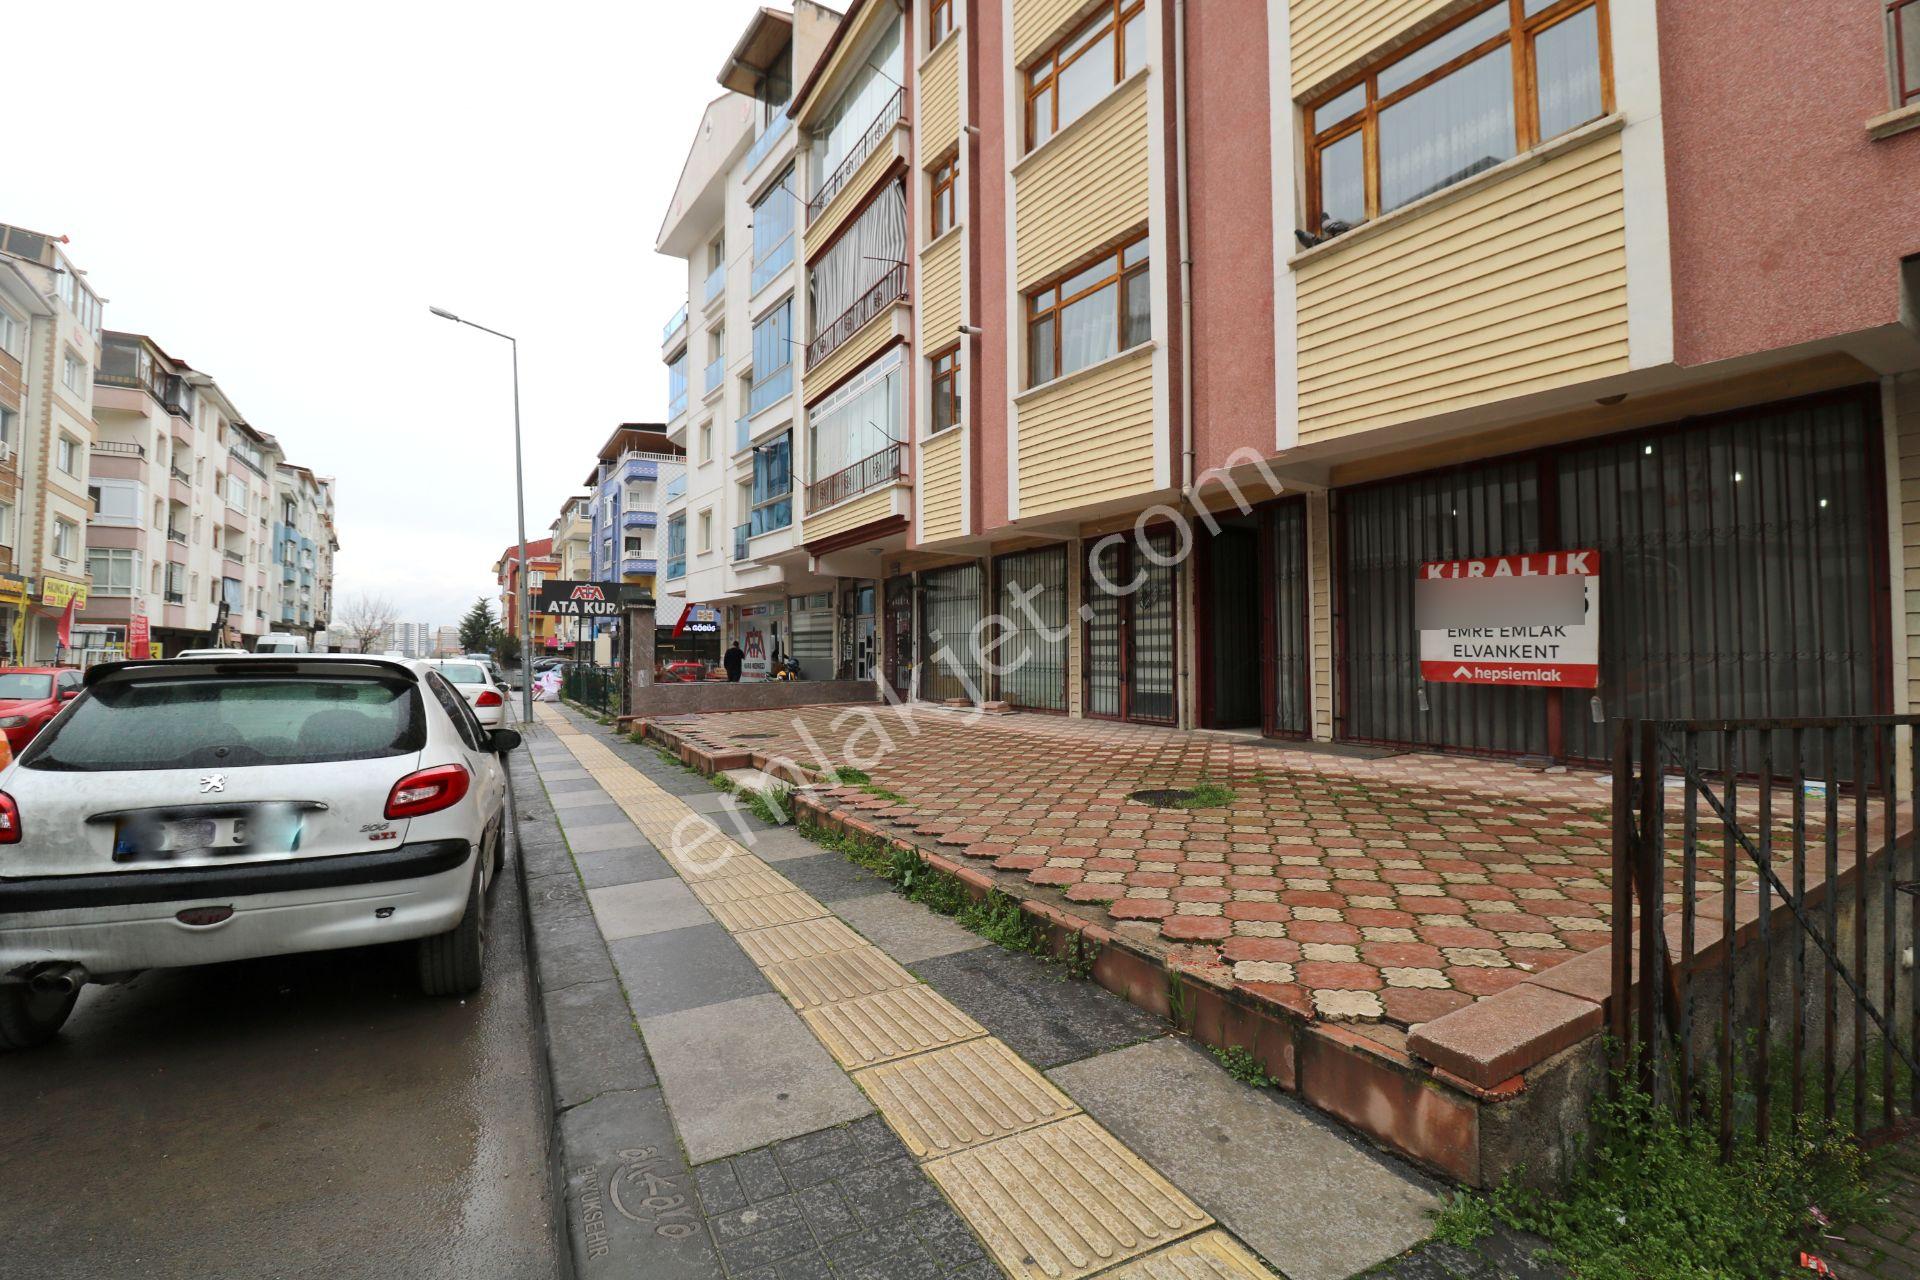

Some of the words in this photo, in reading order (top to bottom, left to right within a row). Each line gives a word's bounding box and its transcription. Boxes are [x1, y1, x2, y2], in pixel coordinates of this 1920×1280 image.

[548, 600, 579, 614] ATA
[584, 601, 619, 615] KUR
[1447, 627, 1494, 638] EMRE
[1500, 625, 1566, 638] EMLAK
[1453, 644, 1560, 659] ELVANKENT
[1474, 666, 1562, 682] hepsiemlak
[359, 822, 391, 833] 206
[617, 1146, 702, 1240] ankara
